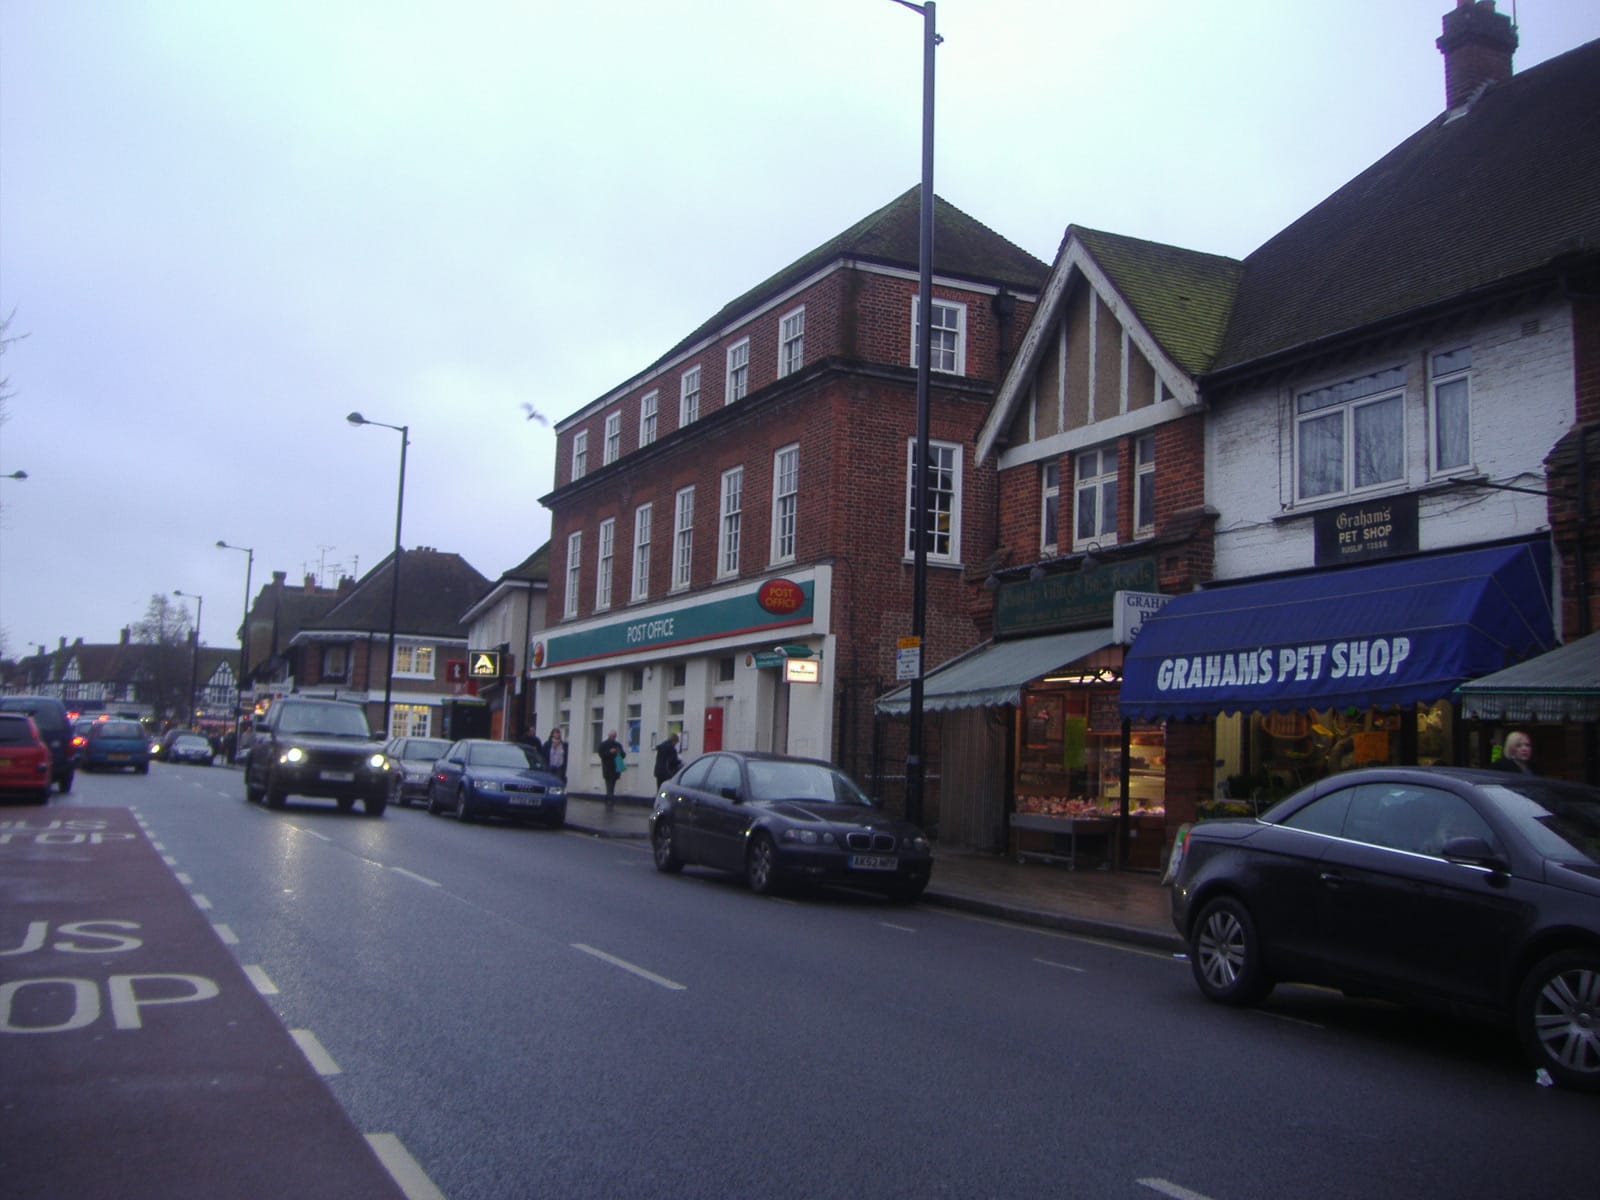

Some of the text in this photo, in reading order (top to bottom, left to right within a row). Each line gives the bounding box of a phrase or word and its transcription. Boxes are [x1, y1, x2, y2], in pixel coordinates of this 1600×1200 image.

[1338, 524, 1393, 544] PET SHOP
[769, 587, 794, 598] POST
[765, 597, 797, 609] OFFICE
[626, 617, 674, 643] POST OFFICE
[1157, 637, 1410, 691] GRAHAM'S PET SHOP
